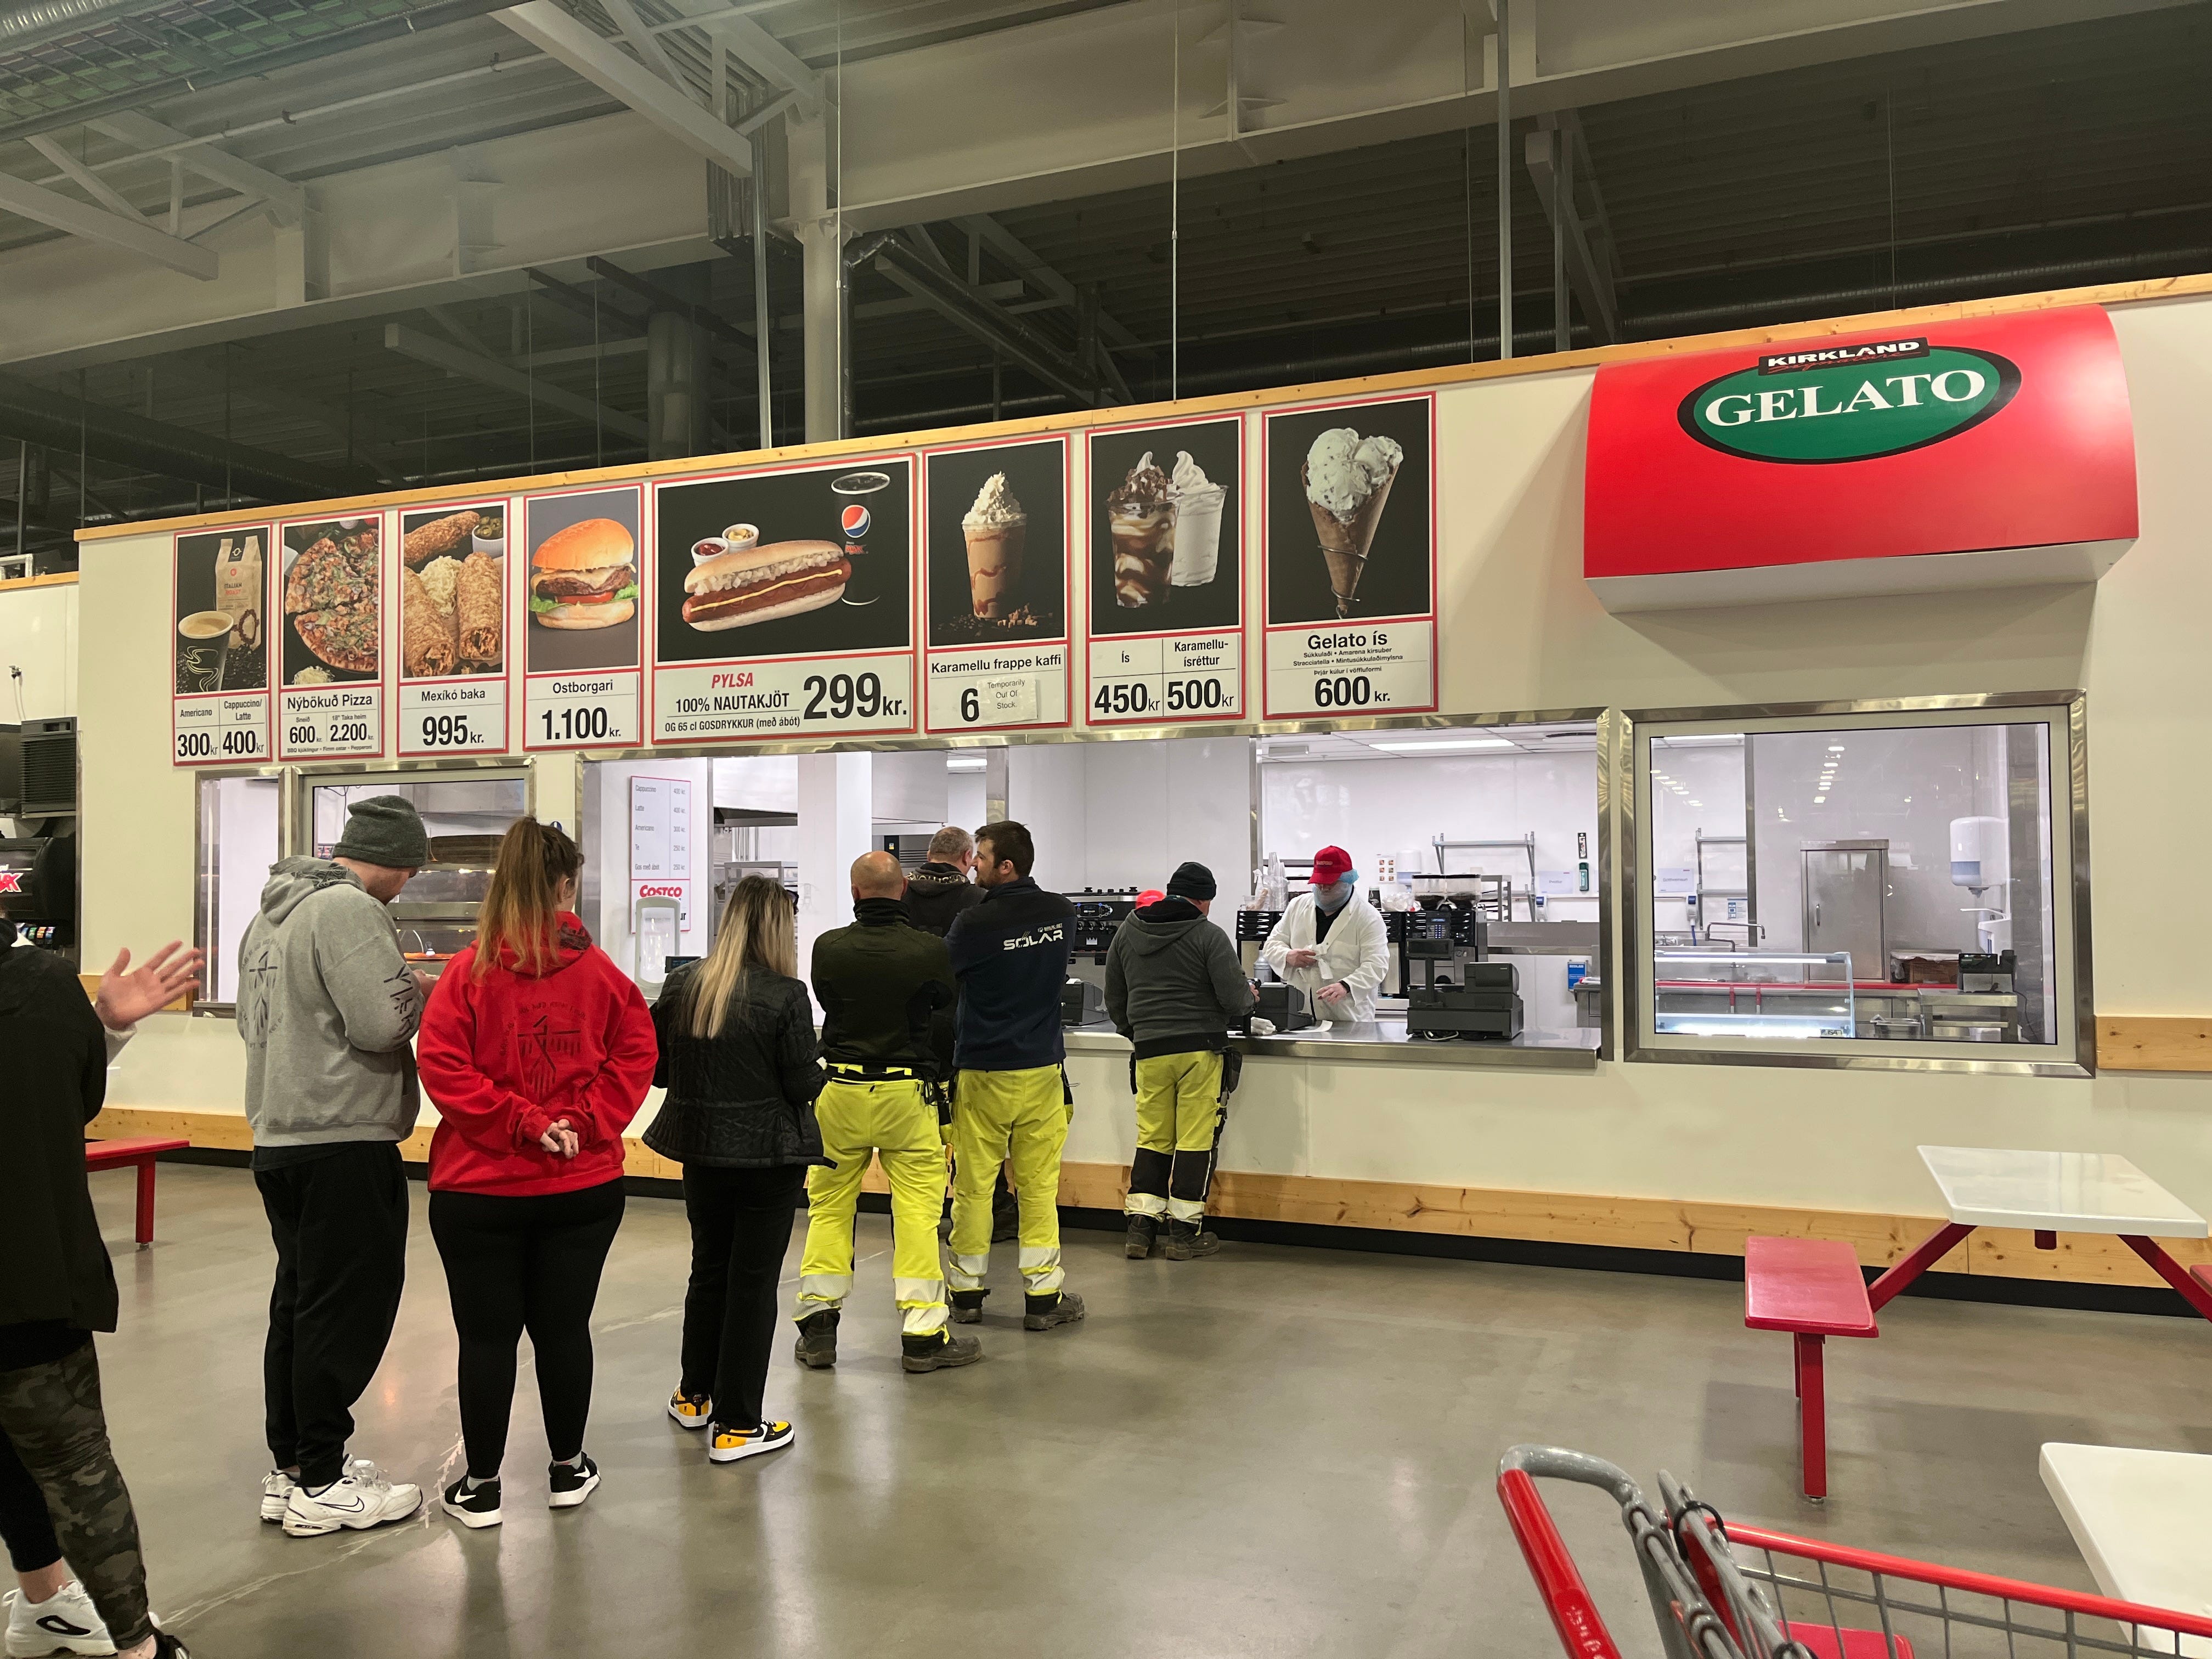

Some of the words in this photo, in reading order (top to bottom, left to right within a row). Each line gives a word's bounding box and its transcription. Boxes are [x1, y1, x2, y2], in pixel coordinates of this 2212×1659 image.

[1768, 341, 1920, 367] KIRKLAND
[1705, 369, 1985, 426] GELATO
[1175, 639, 1228, 652] Karamellu-
[1308, 633, 1366, 650] Gelato
[1373, 630, 1387, 646] ís
[932, 659, 990, 673] Karamellu
[994, 658, 1032, 670] frappe
[1036, 654, 1061, 667] kaffi
[1121, 651, 1130, 663] Ís
[1184, 656, 1220, 667] ísréttur
[552, 679, 613, 695] Ostborgari
[712, 672, 754, 689] PYLSA
[988, 679, 1025, 689] Temporarily
[421, 689, 458, 702] Mexíkó
[460, 689, 486, 700] baka
[1315, 676, 1370, 707] 600
[1374, 691, 1391, 702] kr.
[287, 694, 338, 712] Nýbökuð
[342, 693, 373, 706] Pizza
[676, 697, 710, 713] 100%
[714, 690, 789, 711] NAUTAKJÖT
[180, 709, 212, 717] Americano
[330, 723, 367, 742] 2.200
[422, 715, 468, 746] 995
[665, 723, 676, 732] OG
[678, 722, 687, 731] 65
[690, 721, 697, 730] cl
[699, 719, 754, 730] GOSDRYKKUR
[757, 718, 777, 730] (með
[779, 716, 800, 728] ábót)
[290, 726, 315, 744] 600
[0, 872, 24, 893] AX
[1003, 929, 1064, 950] SOLAR
